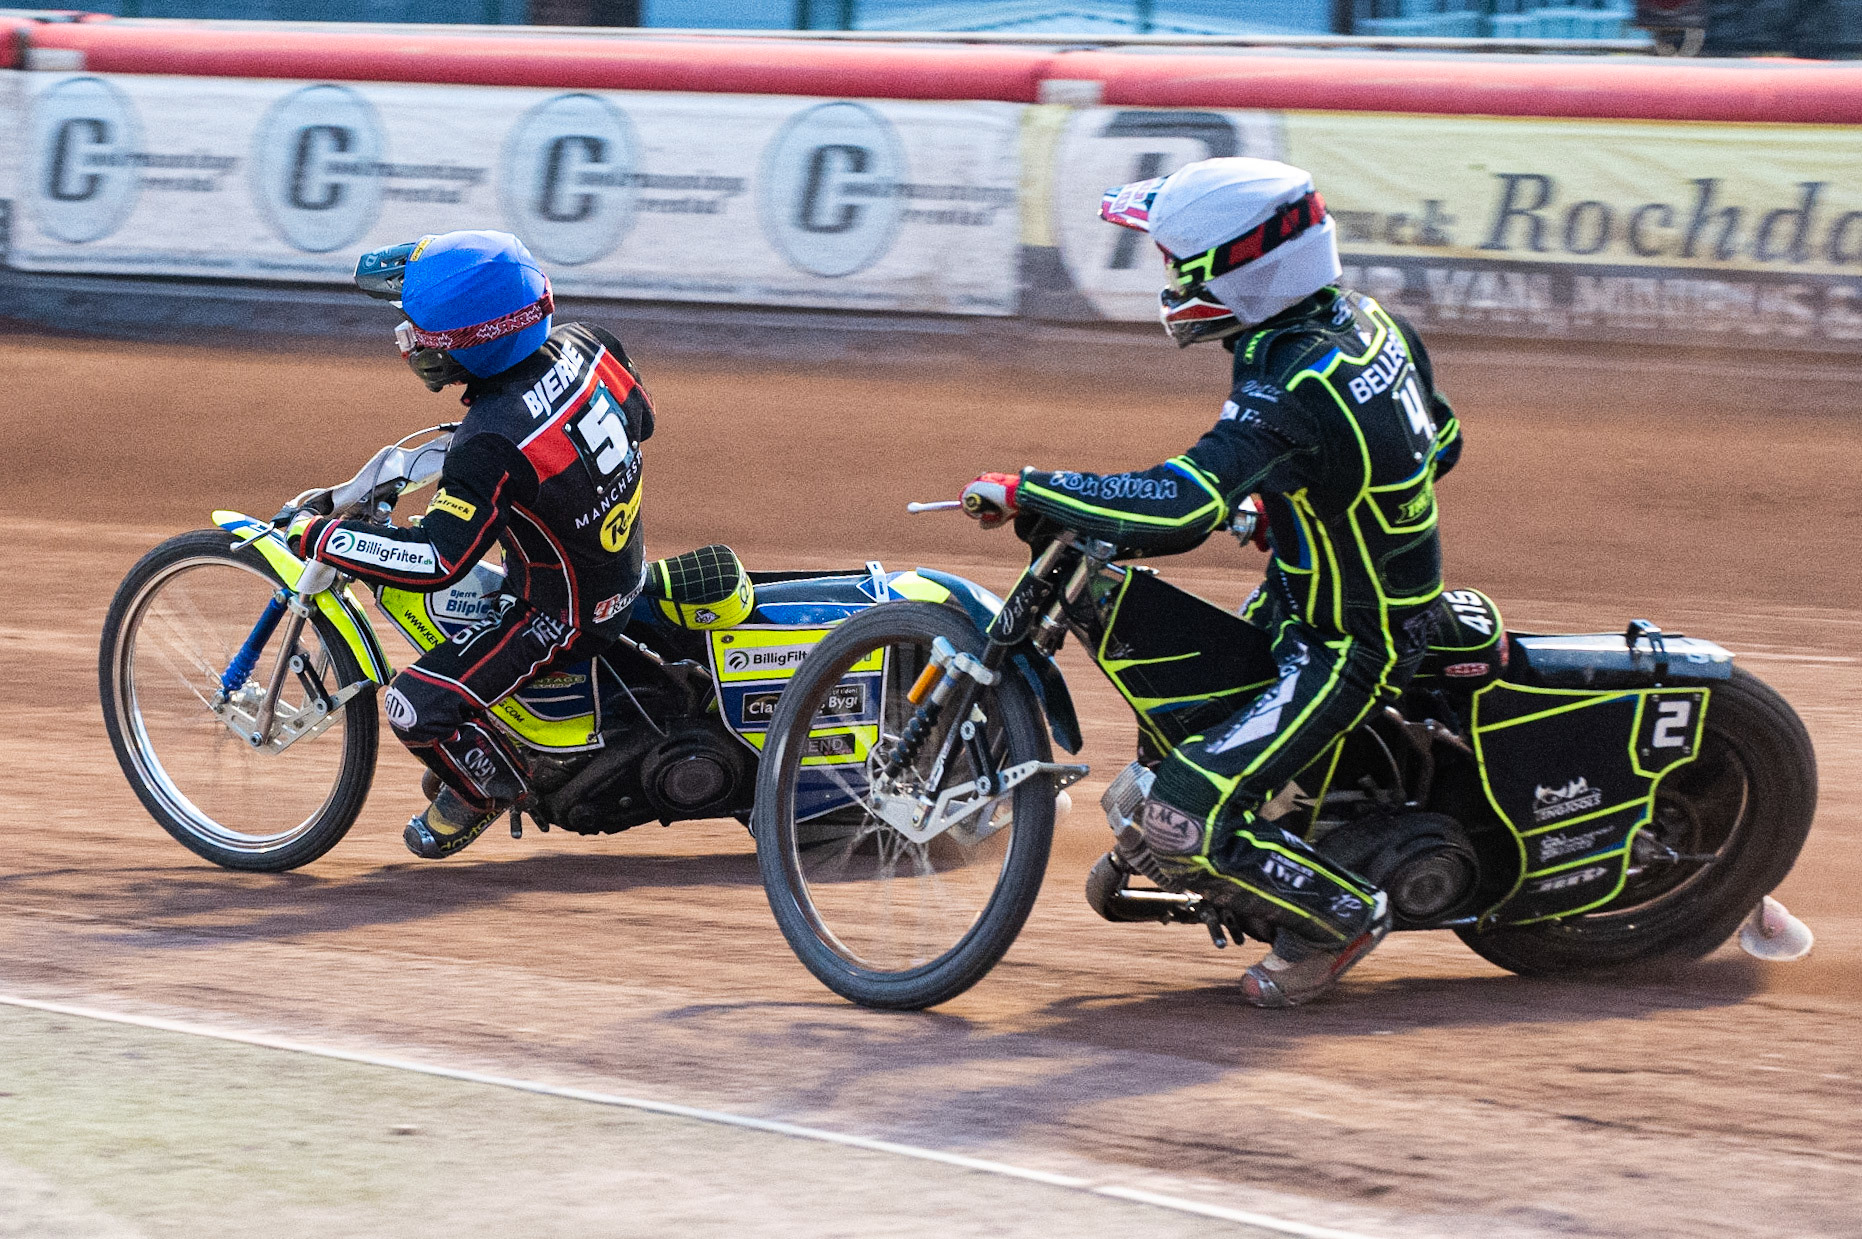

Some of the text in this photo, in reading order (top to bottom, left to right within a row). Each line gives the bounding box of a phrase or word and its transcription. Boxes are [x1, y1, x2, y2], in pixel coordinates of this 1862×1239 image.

[577, 394, 631, 475] 5
[450, 589, 477, 599] Bjerre
[1652, 701, 1691, 748] 2
